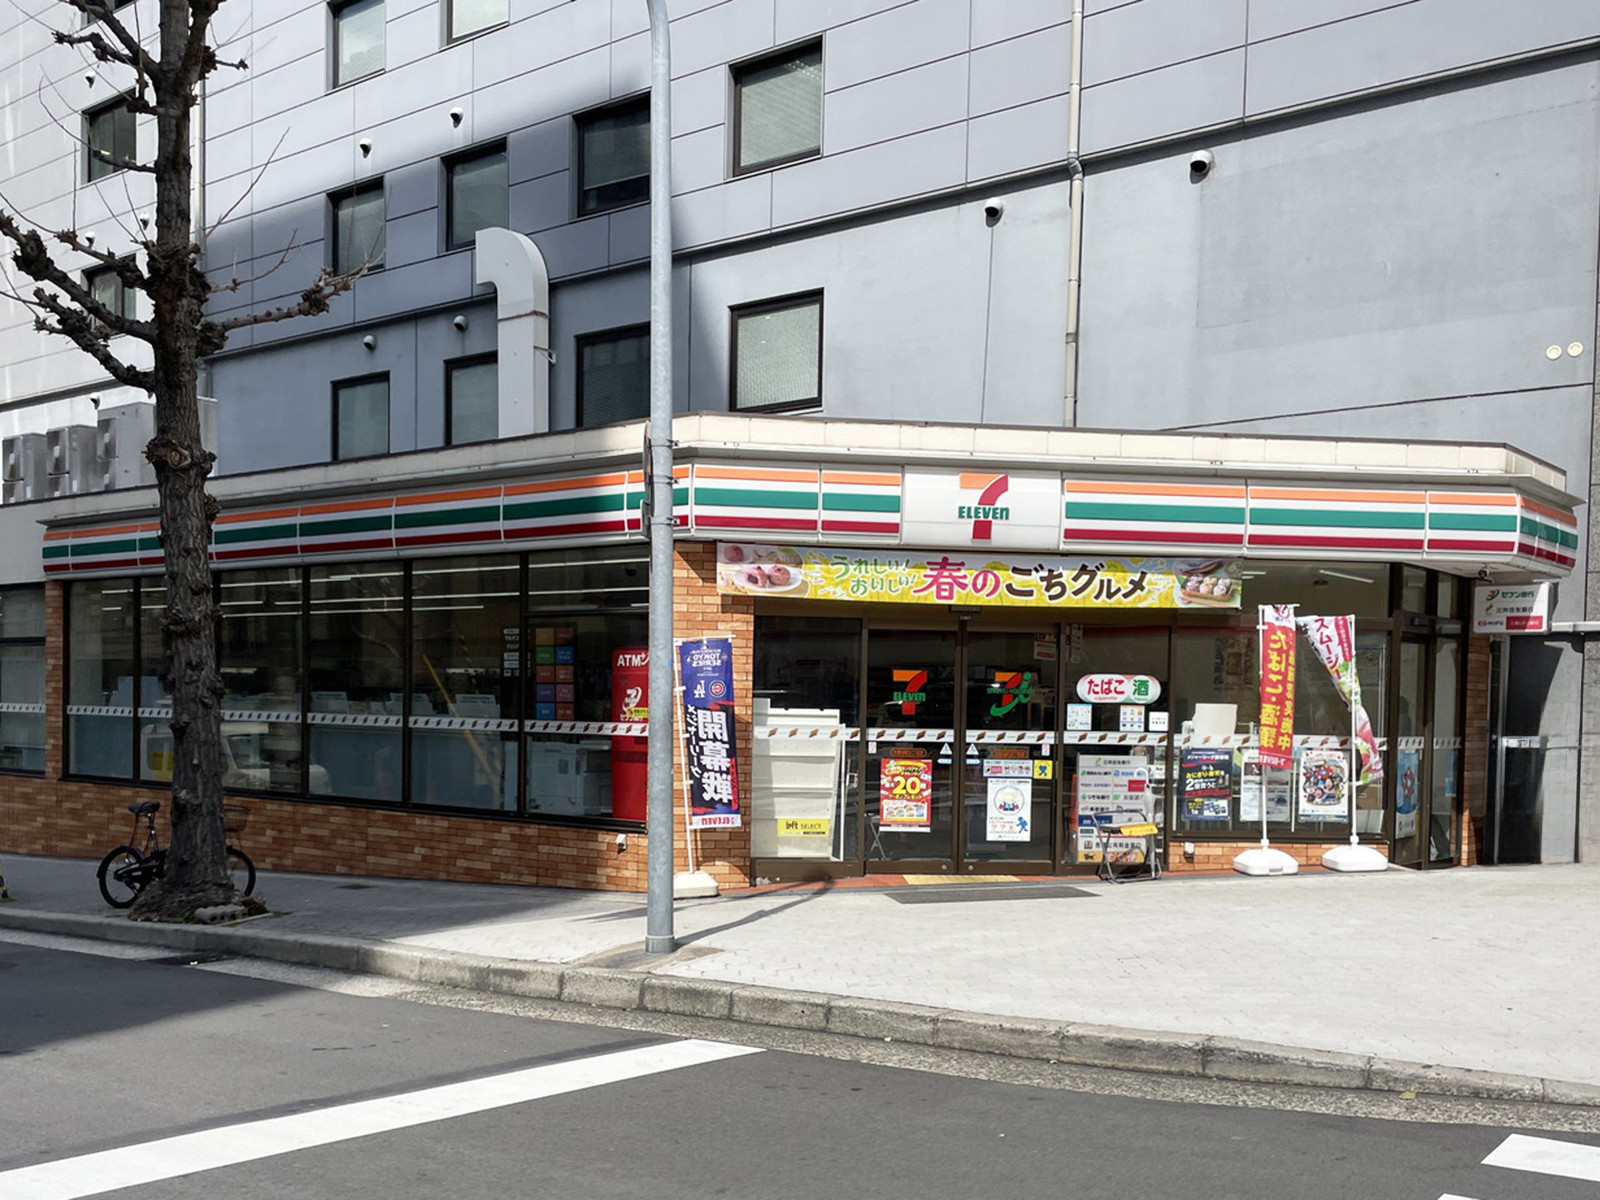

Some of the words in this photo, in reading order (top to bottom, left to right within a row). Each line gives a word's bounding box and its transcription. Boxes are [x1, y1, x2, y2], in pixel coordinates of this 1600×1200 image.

[912, 556, 1148, 602] 春のごちグルメ
[1314, 617, 1342, 680] スムージー
[617, 654, 641, 667] ATM
[1087, 679, 1125, 695] たばこ
[1133, 679, 1150, 696] 酒
